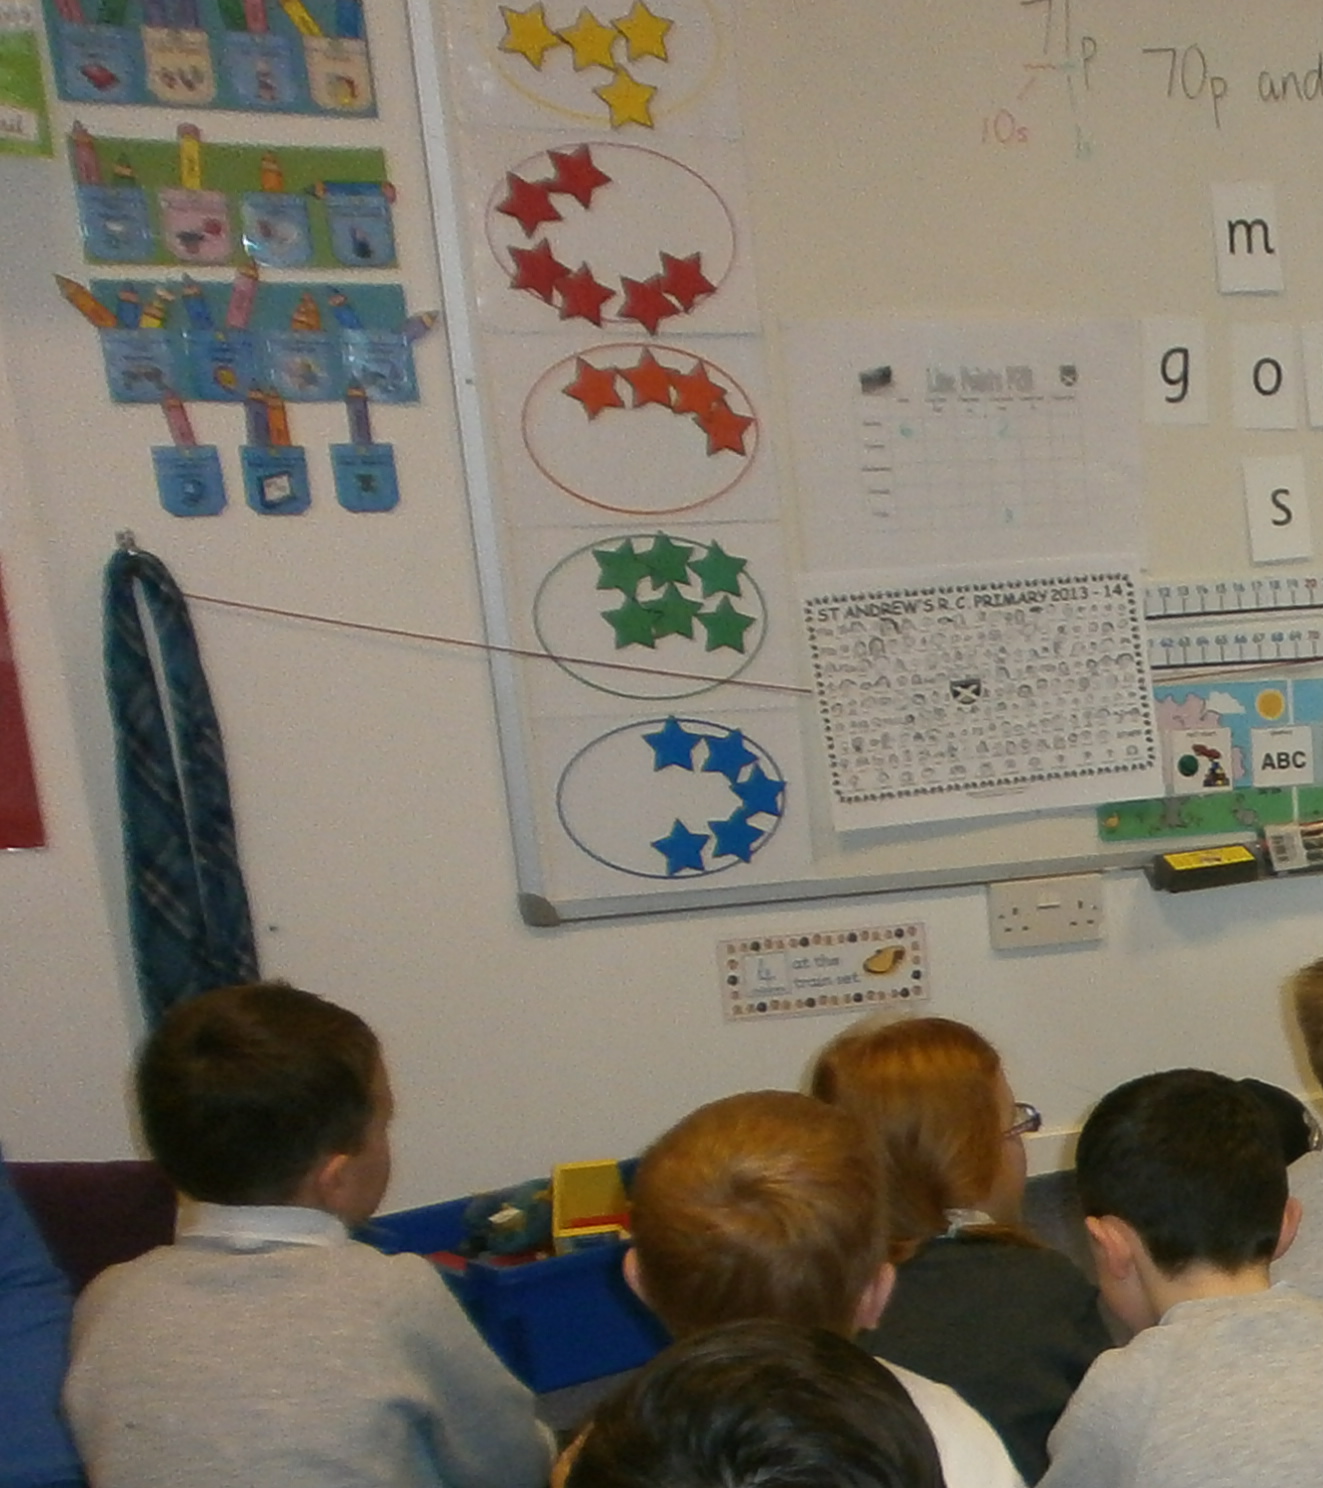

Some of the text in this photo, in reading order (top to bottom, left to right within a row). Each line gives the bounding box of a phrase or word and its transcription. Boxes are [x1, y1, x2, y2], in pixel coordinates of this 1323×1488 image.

[1141, 43, 1228, 129] 70p
[1228, 218, 1275, 254] m
[818, 607, 840, 622] ST
[974, 588, 1047, 608] PRIMARY
[1051, 587, 1089, 603] 2013
[1103, 583, 1124, 597] 14
[1261, 751, 1307, 772] ABC
[792, 955, 840, 970] at the
